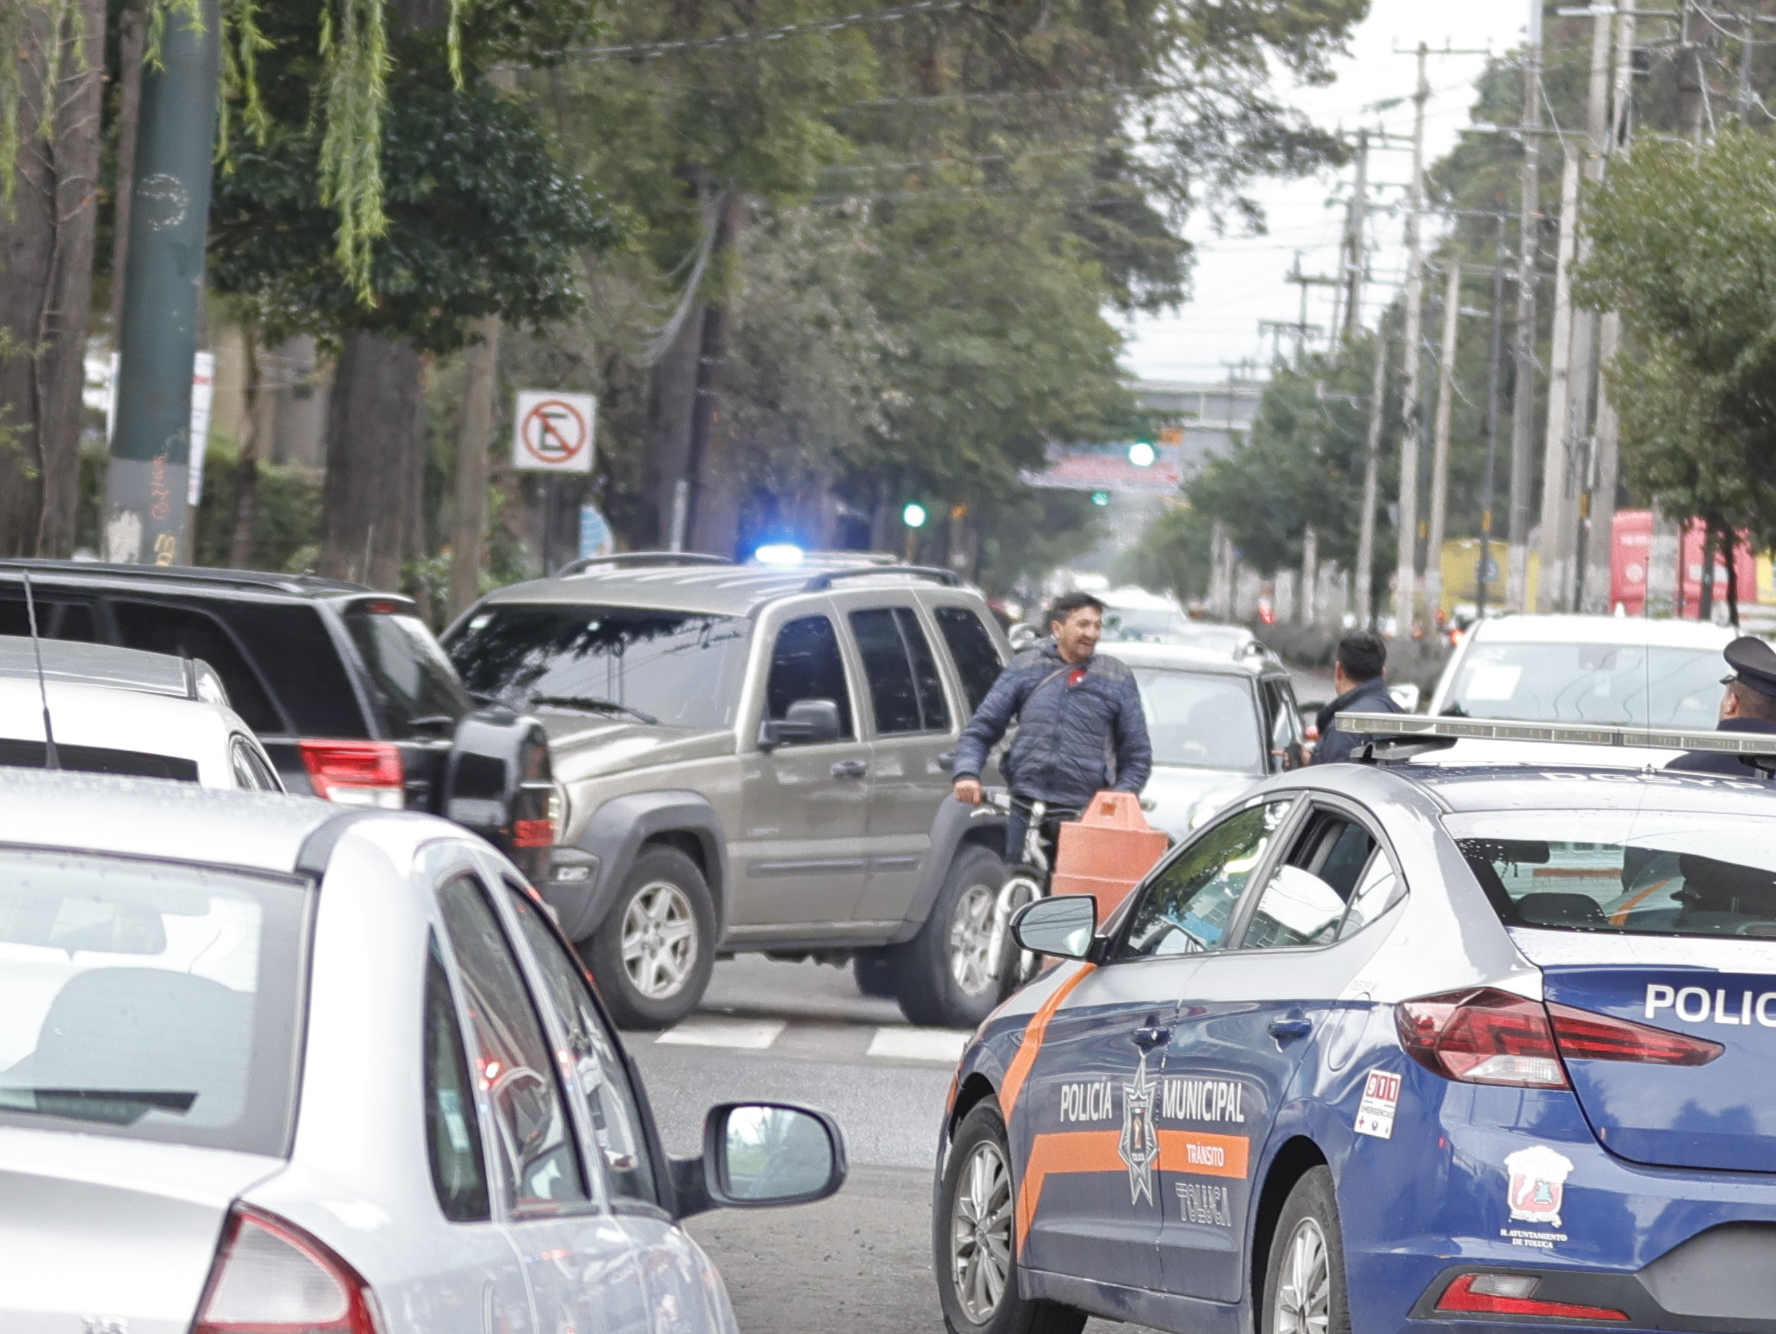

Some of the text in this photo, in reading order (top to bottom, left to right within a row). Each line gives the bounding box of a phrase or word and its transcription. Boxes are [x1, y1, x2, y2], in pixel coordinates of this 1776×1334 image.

[1060, 1076, 1245, 1123] POLICÍA MUNICIPAL
[1367, 1075, 1397, 1101] 911
[1175, 1182, 1232, 1227] TOLUCA
[1508, 1230, 1568, 1242] AYUNTAMIENTO
[1512, 1238, 1554, 1249] DE TOLUCA
